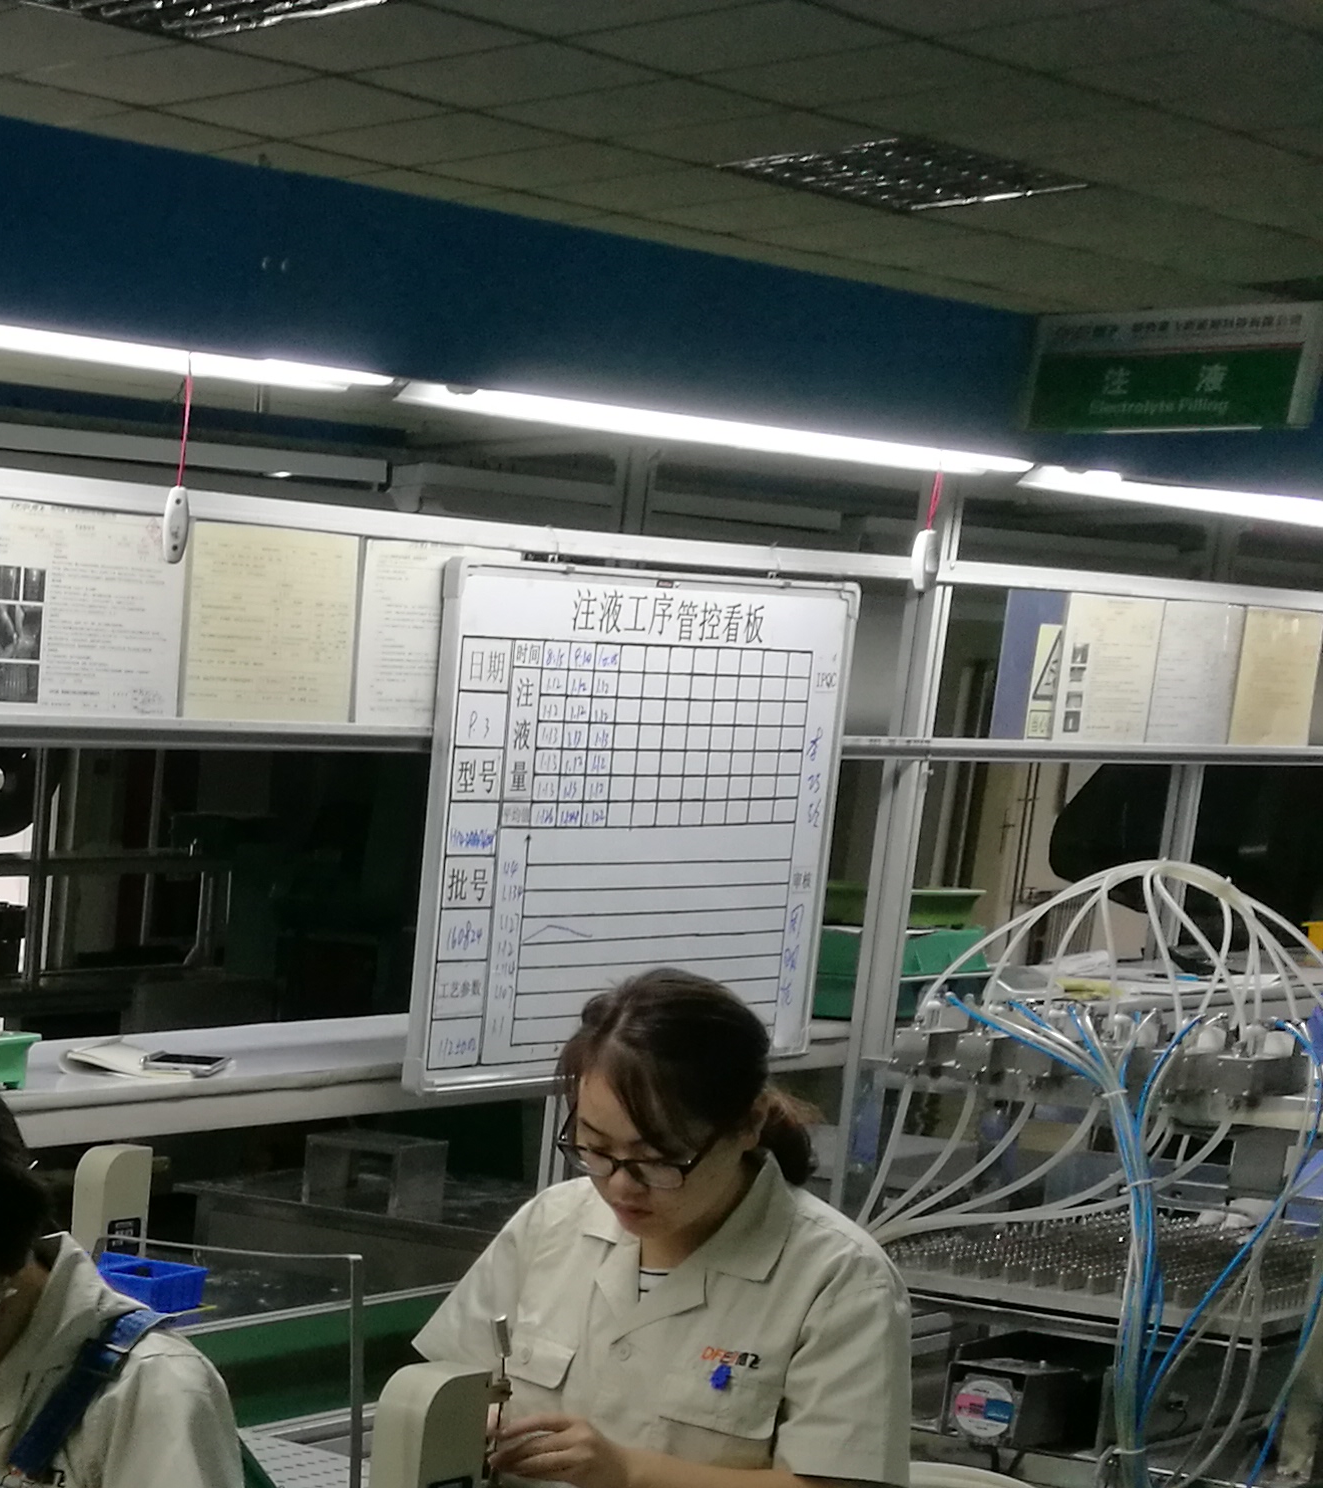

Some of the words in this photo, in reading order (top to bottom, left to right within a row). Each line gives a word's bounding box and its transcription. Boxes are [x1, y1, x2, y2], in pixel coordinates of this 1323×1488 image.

[572, 588, 765, 644] 注液工序管控看板
[469, 650, 506, 684] 日期
[516, 643, 541, 665] 时间
[816, 671, 837, 689] IPQC
[456, 759, 497, 794] 型号
[447, 867, 488, 903] 批号
[793, 871, 812, 890] 审核
[439, 981, 482, 999] 工艺参数
